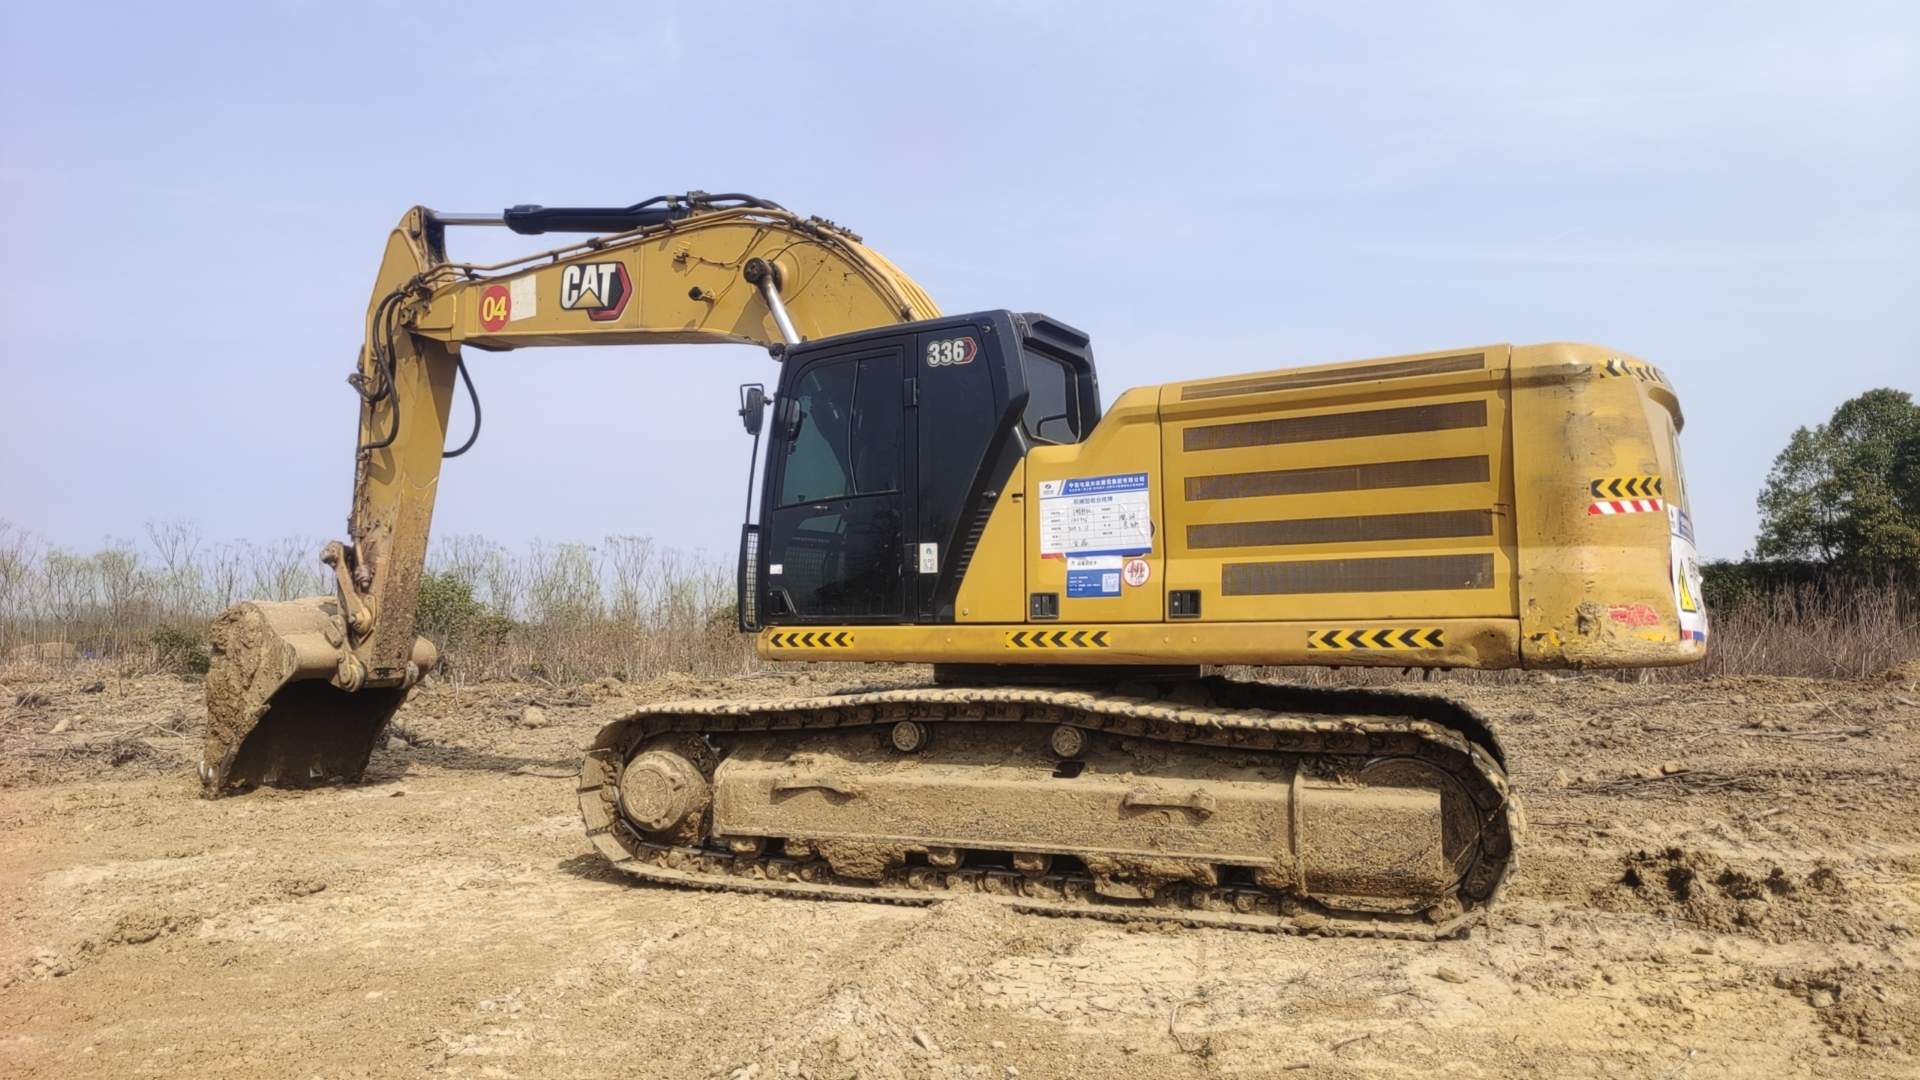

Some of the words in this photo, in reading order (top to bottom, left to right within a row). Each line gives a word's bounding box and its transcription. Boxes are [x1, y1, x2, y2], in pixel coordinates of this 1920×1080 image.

[562, 264, 617, 309] CAT
[482, 296, 507, 322] 04
[928, 340, 965, 365] 336
